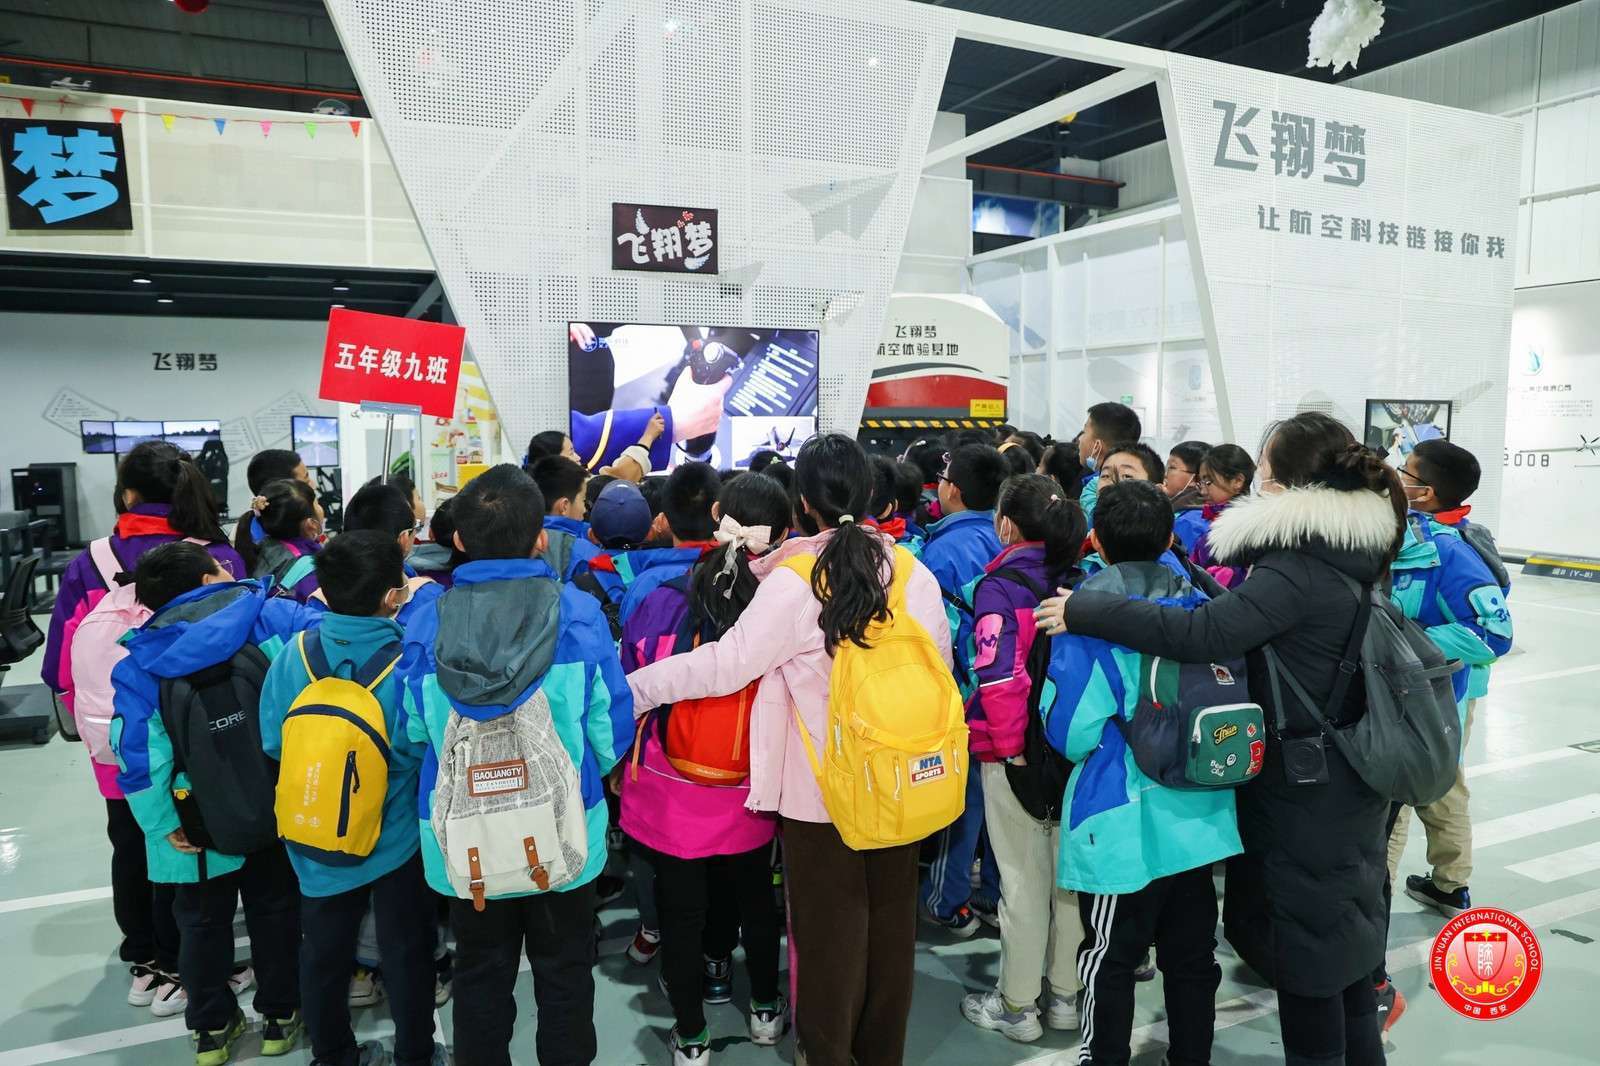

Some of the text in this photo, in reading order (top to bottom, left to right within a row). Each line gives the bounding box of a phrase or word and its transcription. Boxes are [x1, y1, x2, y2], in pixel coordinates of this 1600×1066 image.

[1212, 98, 1367, 188] 飞翔梦
[11, 126, 119, 224] 梦
[616, 217, 714, 264] 飞翔梦
[1257, 204, 1506, 259] 让航空科技链接你我
[895, 324, 937, 339] 飞翔梦
[151, 352, 218, 371] 飞翔梦
[333, 342, 450, 385] 五年级九班
[474, 766, 522, 781] BAOLIANGTY
[913, 755, 942, 771] ANTA
[915, 767, 942, 781] SPORTS
